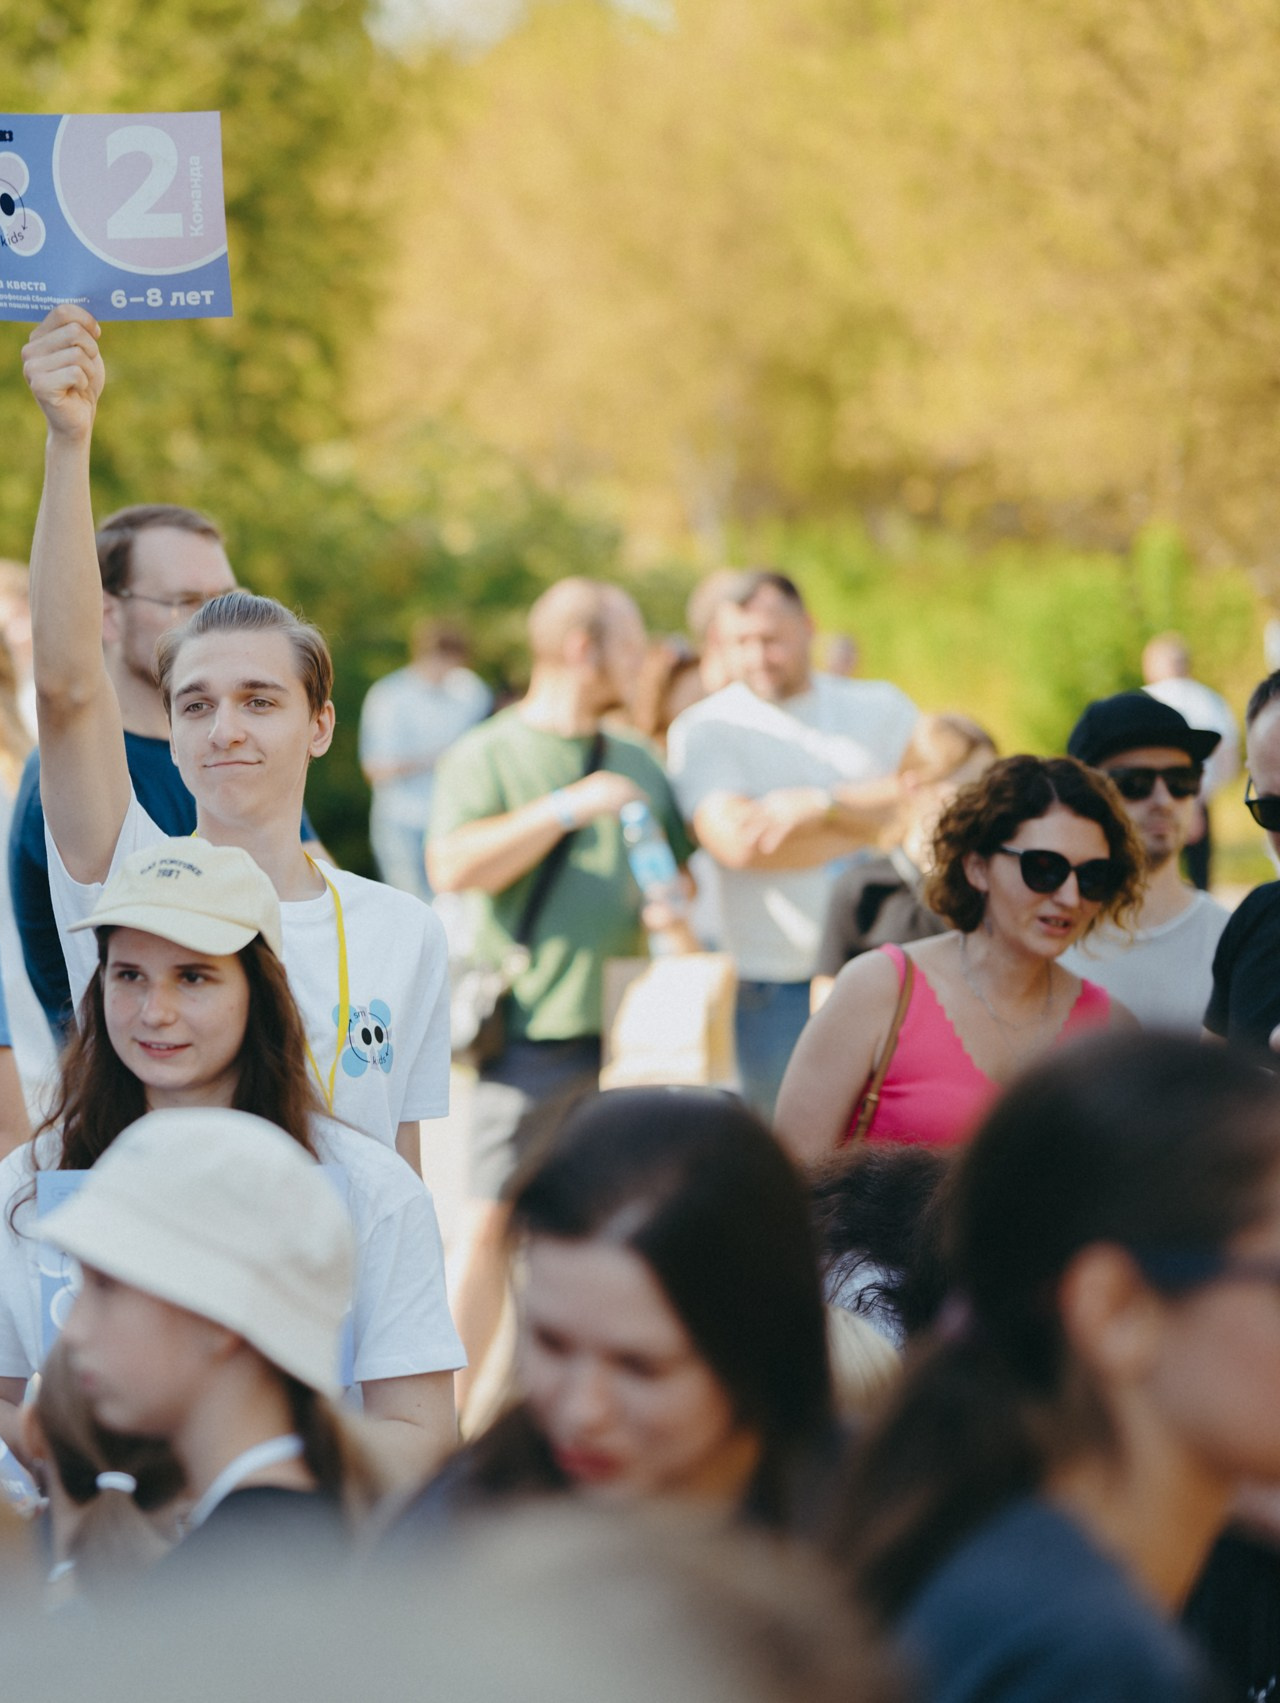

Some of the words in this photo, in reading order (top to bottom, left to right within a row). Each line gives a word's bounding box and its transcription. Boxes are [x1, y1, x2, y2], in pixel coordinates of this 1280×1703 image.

[106, 125, 184, 240] 2
[190, 155, 204, 237] Команда
[0, 231, 25, 248] kids
[6, 280, 47, 292] квеста
[170, 289, 215, 307] лет
